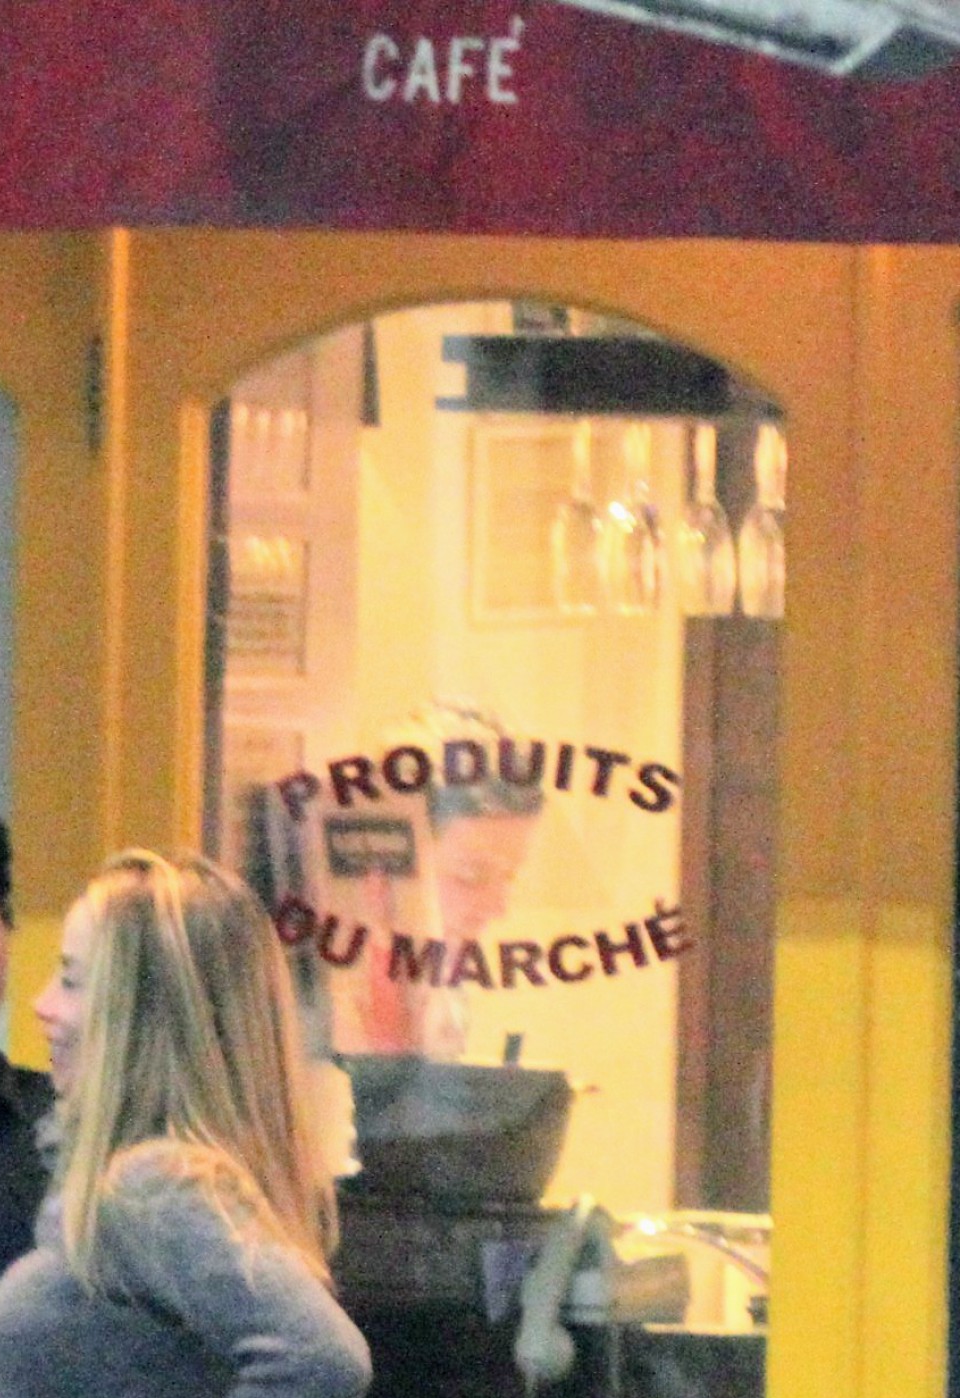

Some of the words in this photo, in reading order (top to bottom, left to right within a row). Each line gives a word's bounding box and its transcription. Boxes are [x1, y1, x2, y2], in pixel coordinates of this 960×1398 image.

[362, 14, 526, 104] CAFÉ
[275, 737, 683, 822] PRODUITS
[386, 897, 696, 990] MARCHÉ
